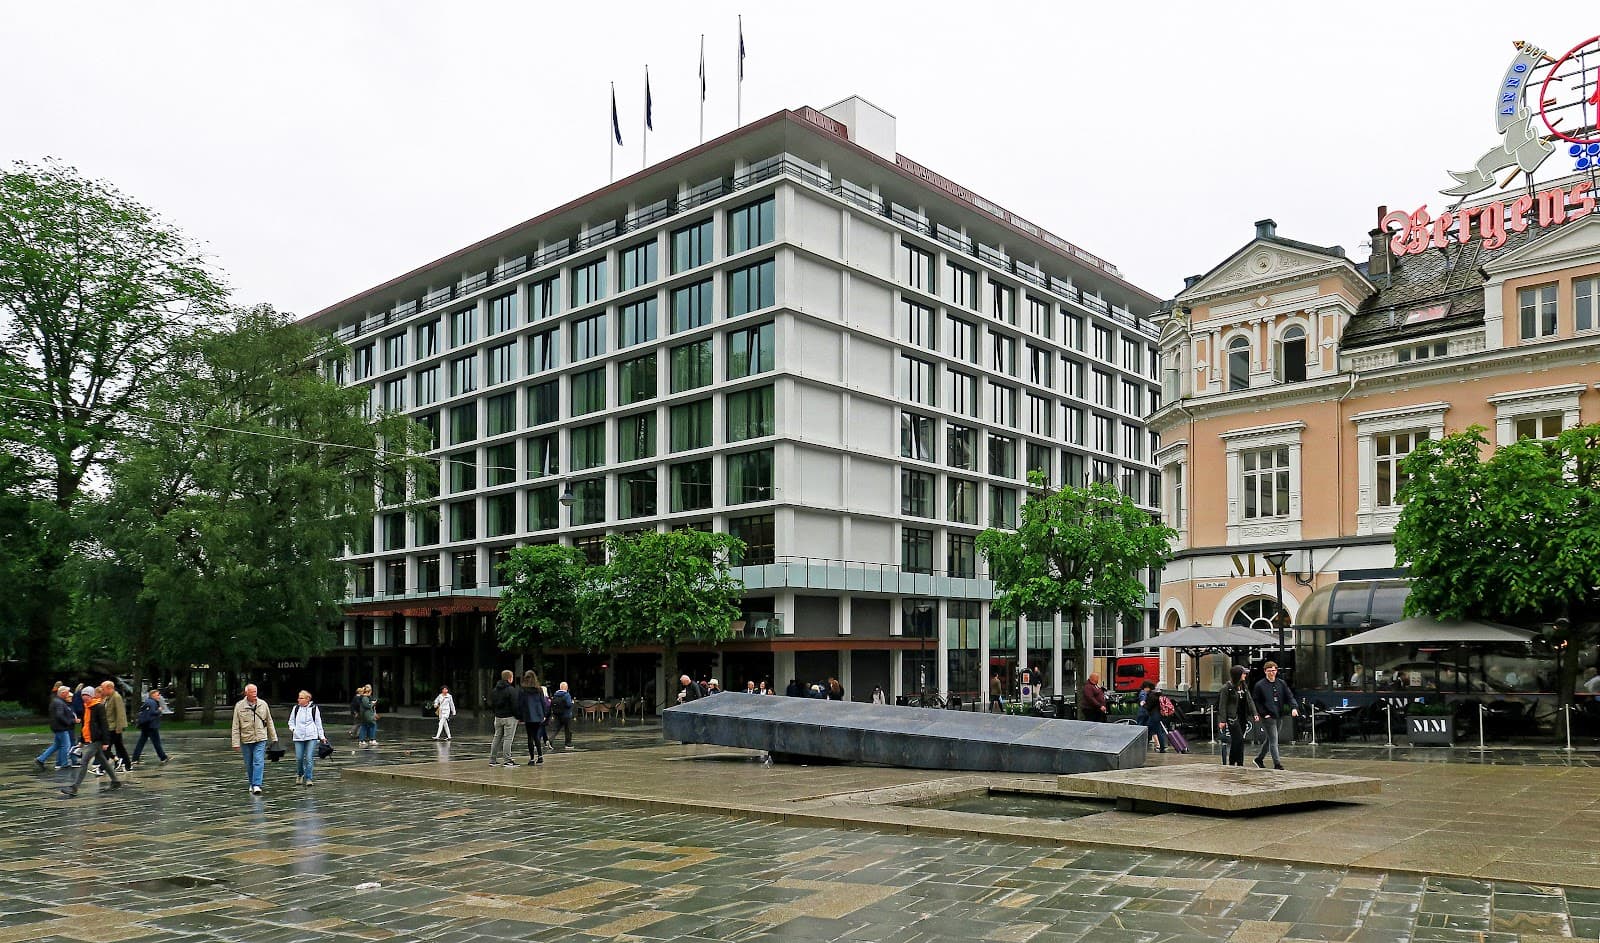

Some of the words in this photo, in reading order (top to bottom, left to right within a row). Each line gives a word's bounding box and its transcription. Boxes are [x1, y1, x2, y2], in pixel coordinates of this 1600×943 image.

[1501, 63, 1527, 115] ANNO
[1380, 181, 1596, 256] Bergens
[1413, 719, 1447, 733] MM
